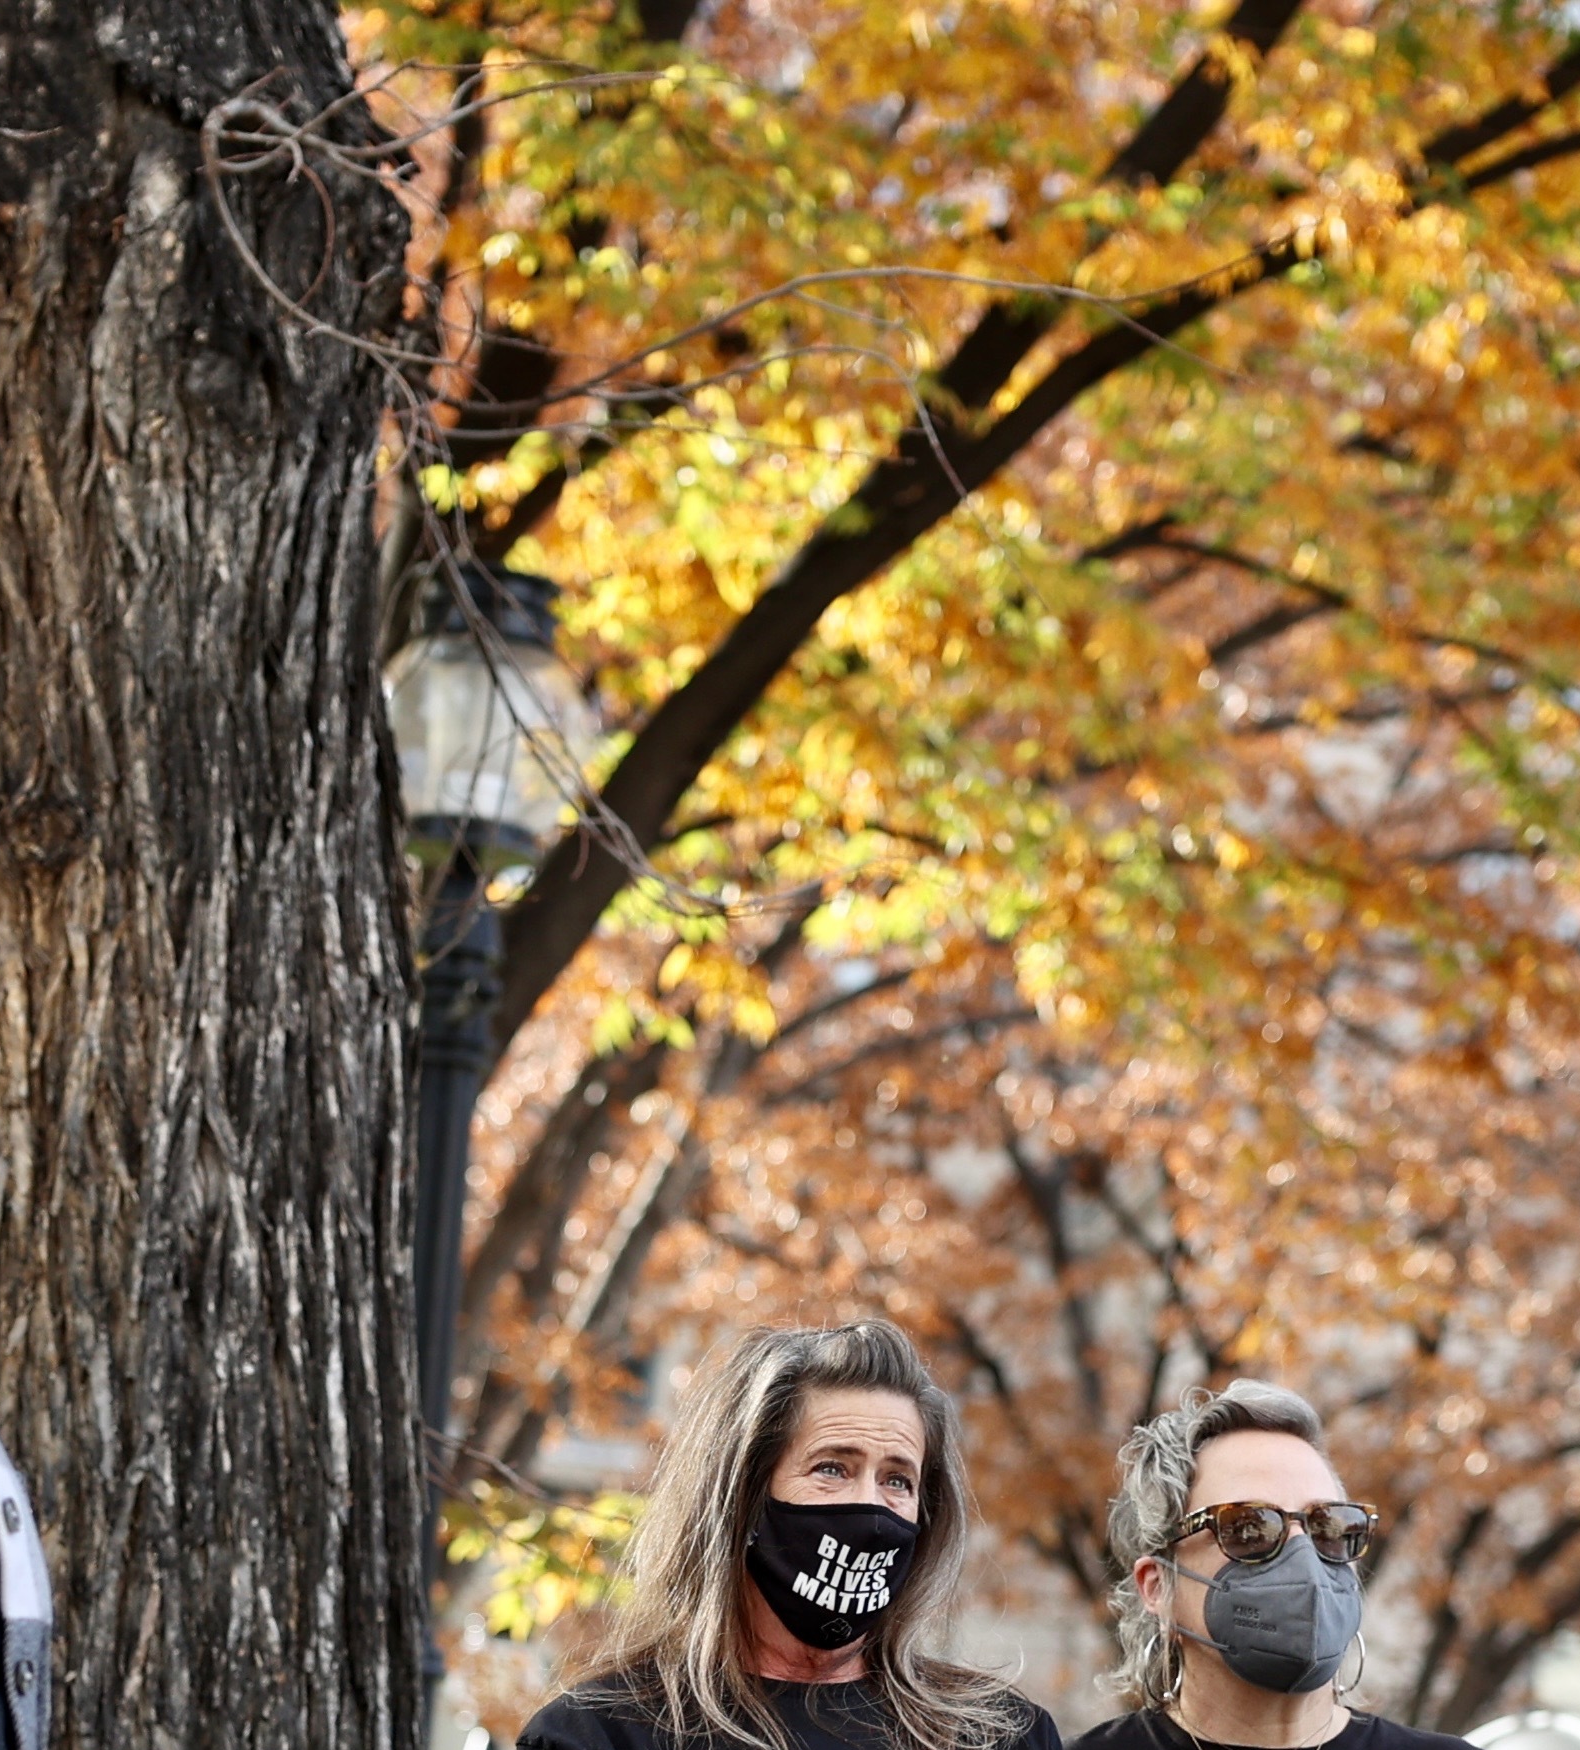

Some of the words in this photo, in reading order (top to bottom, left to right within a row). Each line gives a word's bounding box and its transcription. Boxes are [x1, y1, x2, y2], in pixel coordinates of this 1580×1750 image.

[817, 1534, 900, 1571] BLACK
[792, 1571, 890, 1615] MATTER
[816, 1558, 887, 1592] LIVES
